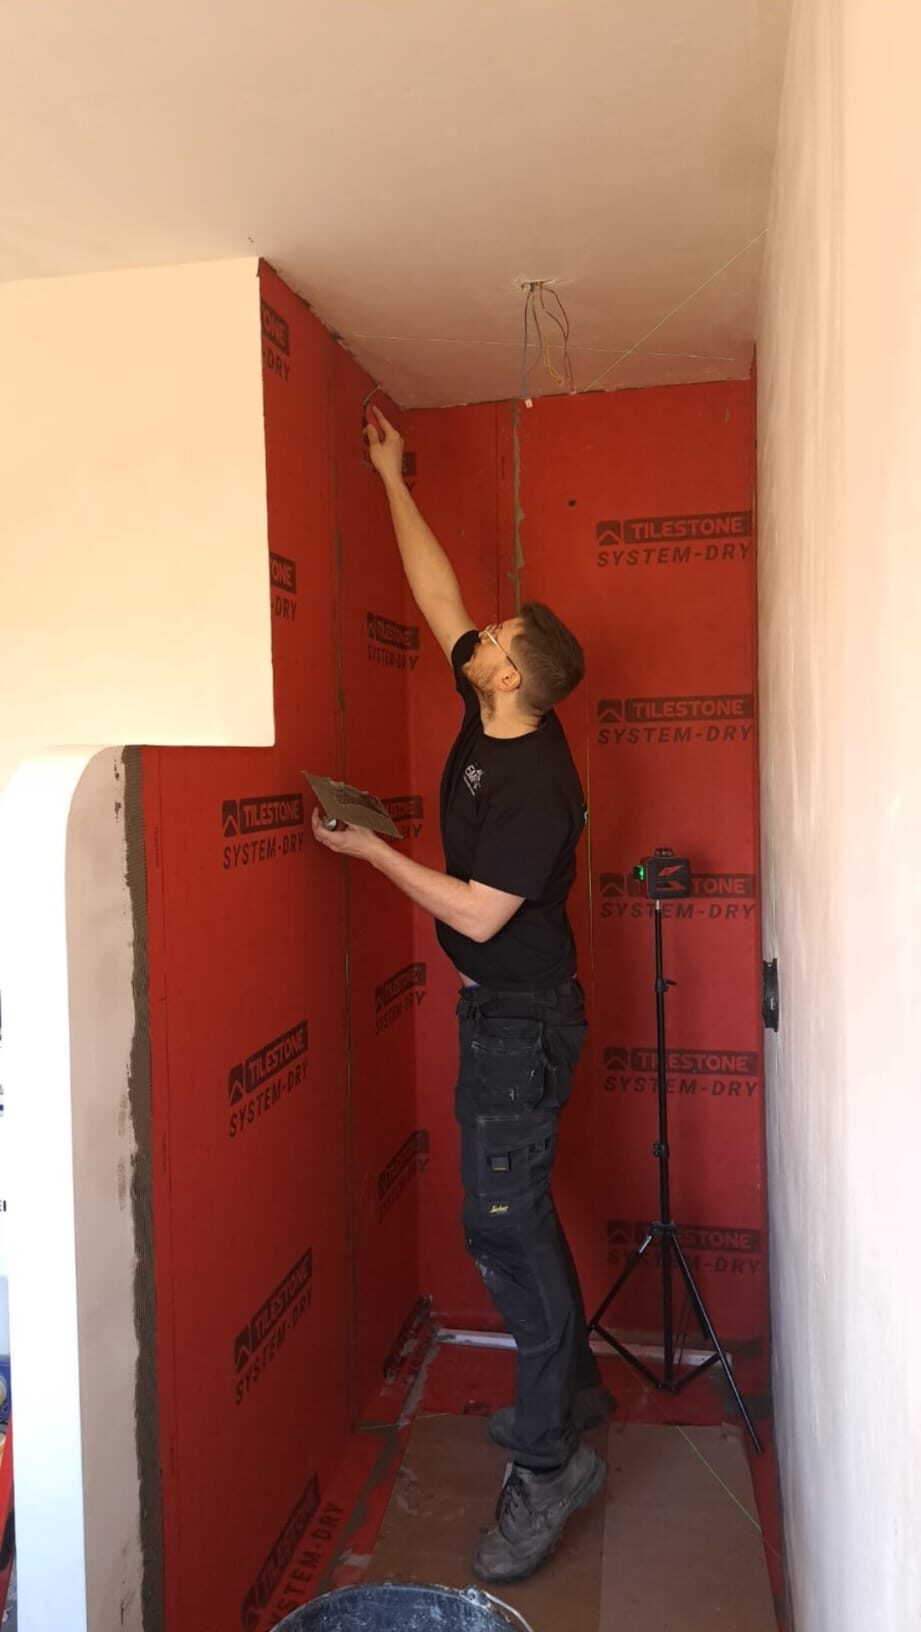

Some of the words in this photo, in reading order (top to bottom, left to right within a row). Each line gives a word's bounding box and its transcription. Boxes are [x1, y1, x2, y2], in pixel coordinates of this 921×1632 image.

[631, 516, 743, 541] TILESTONE
[596, 543, 752, 567] SYSTEM-DRY
[633, 699, 744, 720] TILESTONE
[597, 725, 753, 745] SYSTEM-DRY
[243, 801, 300, 828] TILESTONE
[223, 833, 304, 870] SYSTEM-DRY
[248, 1027, 304, 1085] TILESTONE
[638, 1052, 750, 1073] TIESTONE
[229, 1059, 309, 1138] SYSTEM-DRY
